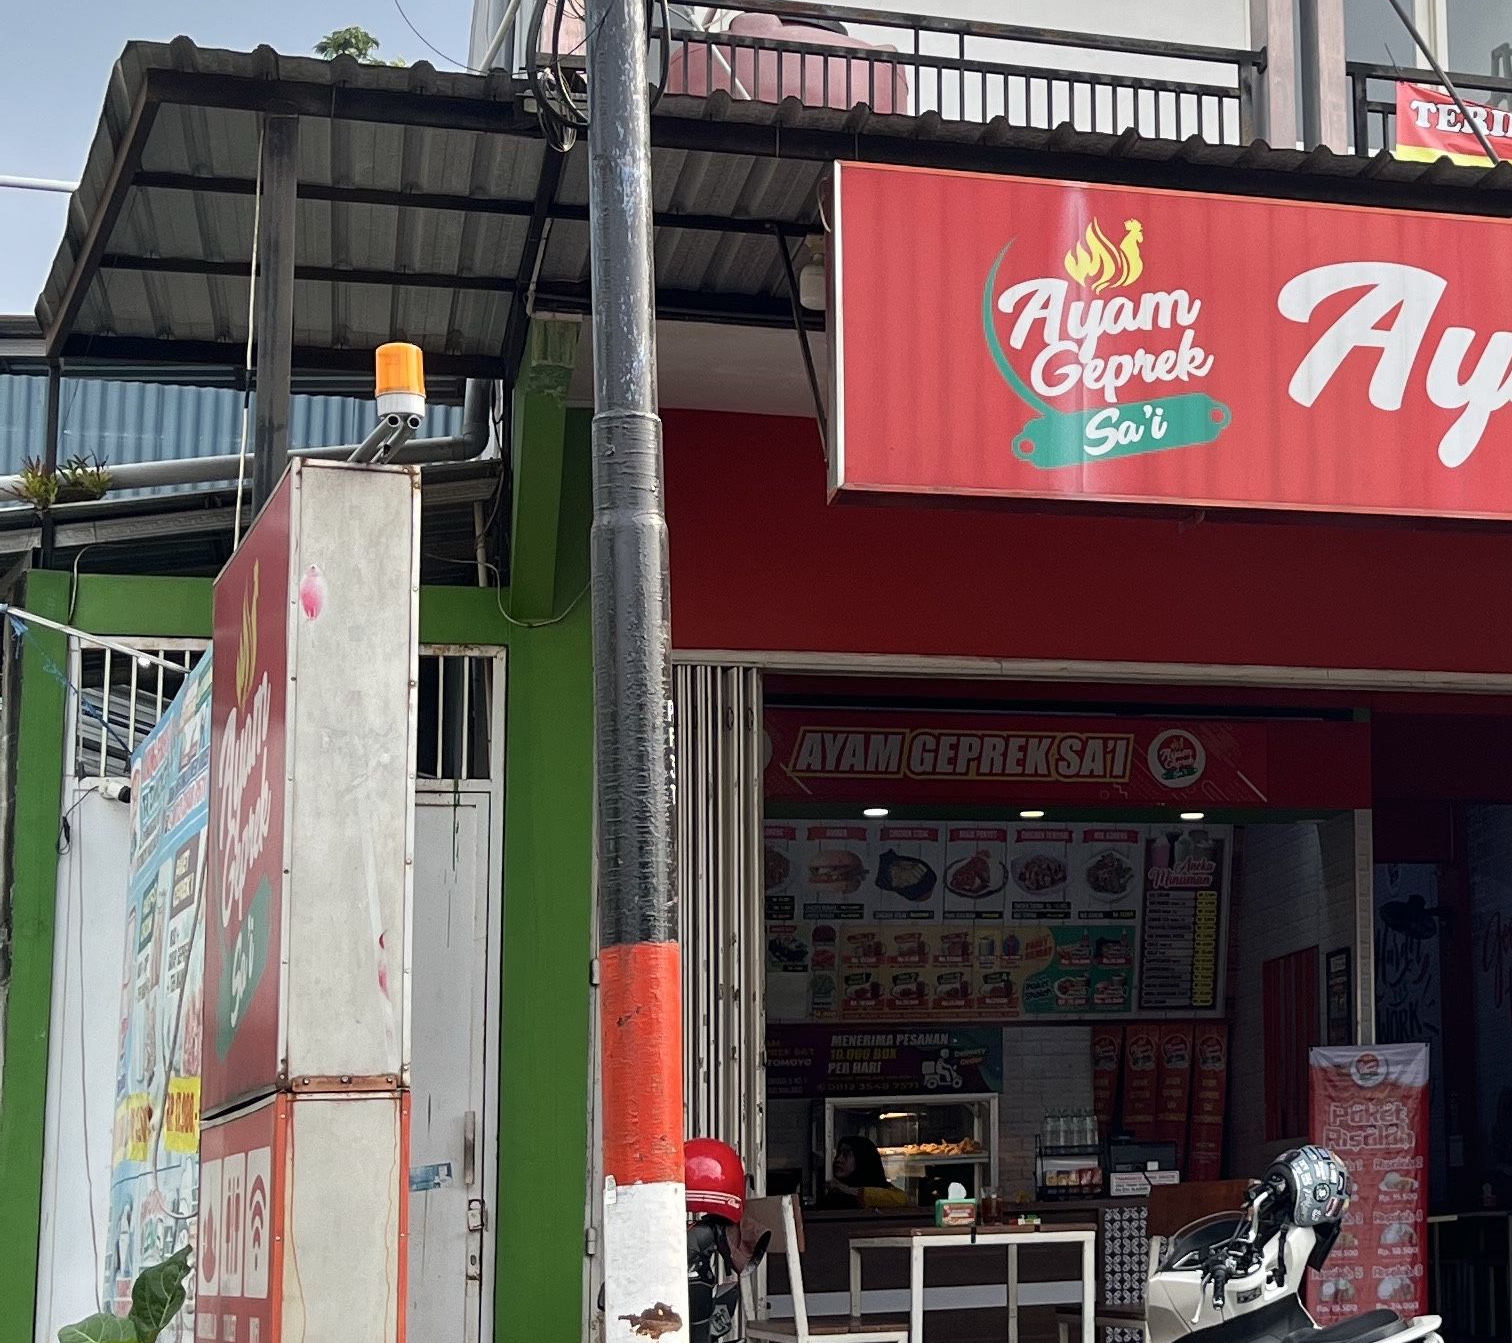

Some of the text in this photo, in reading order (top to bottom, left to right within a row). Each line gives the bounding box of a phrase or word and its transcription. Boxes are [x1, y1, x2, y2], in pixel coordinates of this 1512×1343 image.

[998, 275, 1202, 365] Ayam
[1031, 338, 1214, 403] Geprek
[1083, 405, 1168, 457] Sa'i
[219, 671, 272, 850] Ayam
[799, 731, 1131, 779] AYAM GEPREK SA'I
[221, 746, 272, 928] Geprek
[831, 1033, 950, 1047] MENERIMA PESANAN
[1375, 999, 1423, 1044] WORK
[828, 1060, 882, 1075] PER HARI
